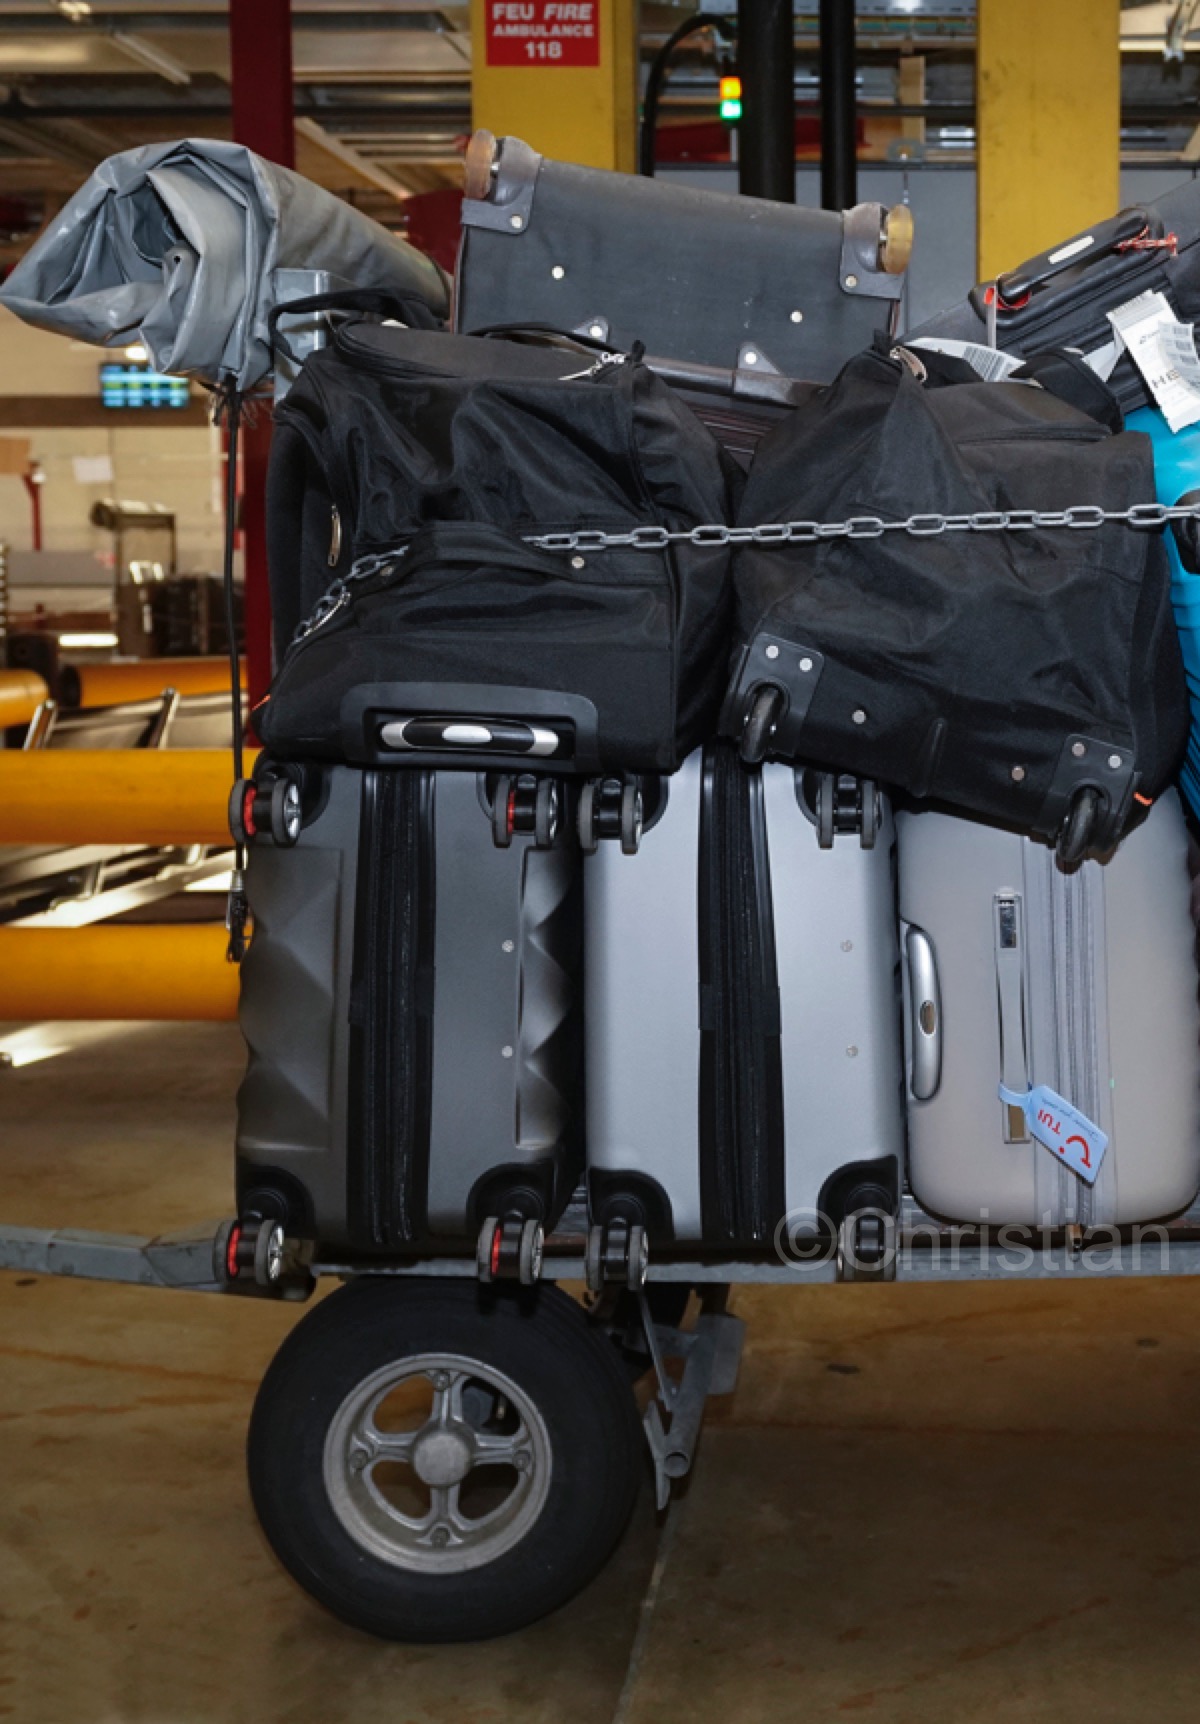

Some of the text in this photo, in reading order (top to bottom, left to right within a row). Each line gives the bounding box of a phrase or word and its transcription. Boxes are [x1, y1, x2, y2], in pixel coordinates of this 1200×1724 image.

[492, 3, 593, 20] FEU FIRE
[492, 23, 594, 37] AMBULANCE
[524, 41, 562, 59] 118
[1037, 1109, 1060, 1135] TUI
